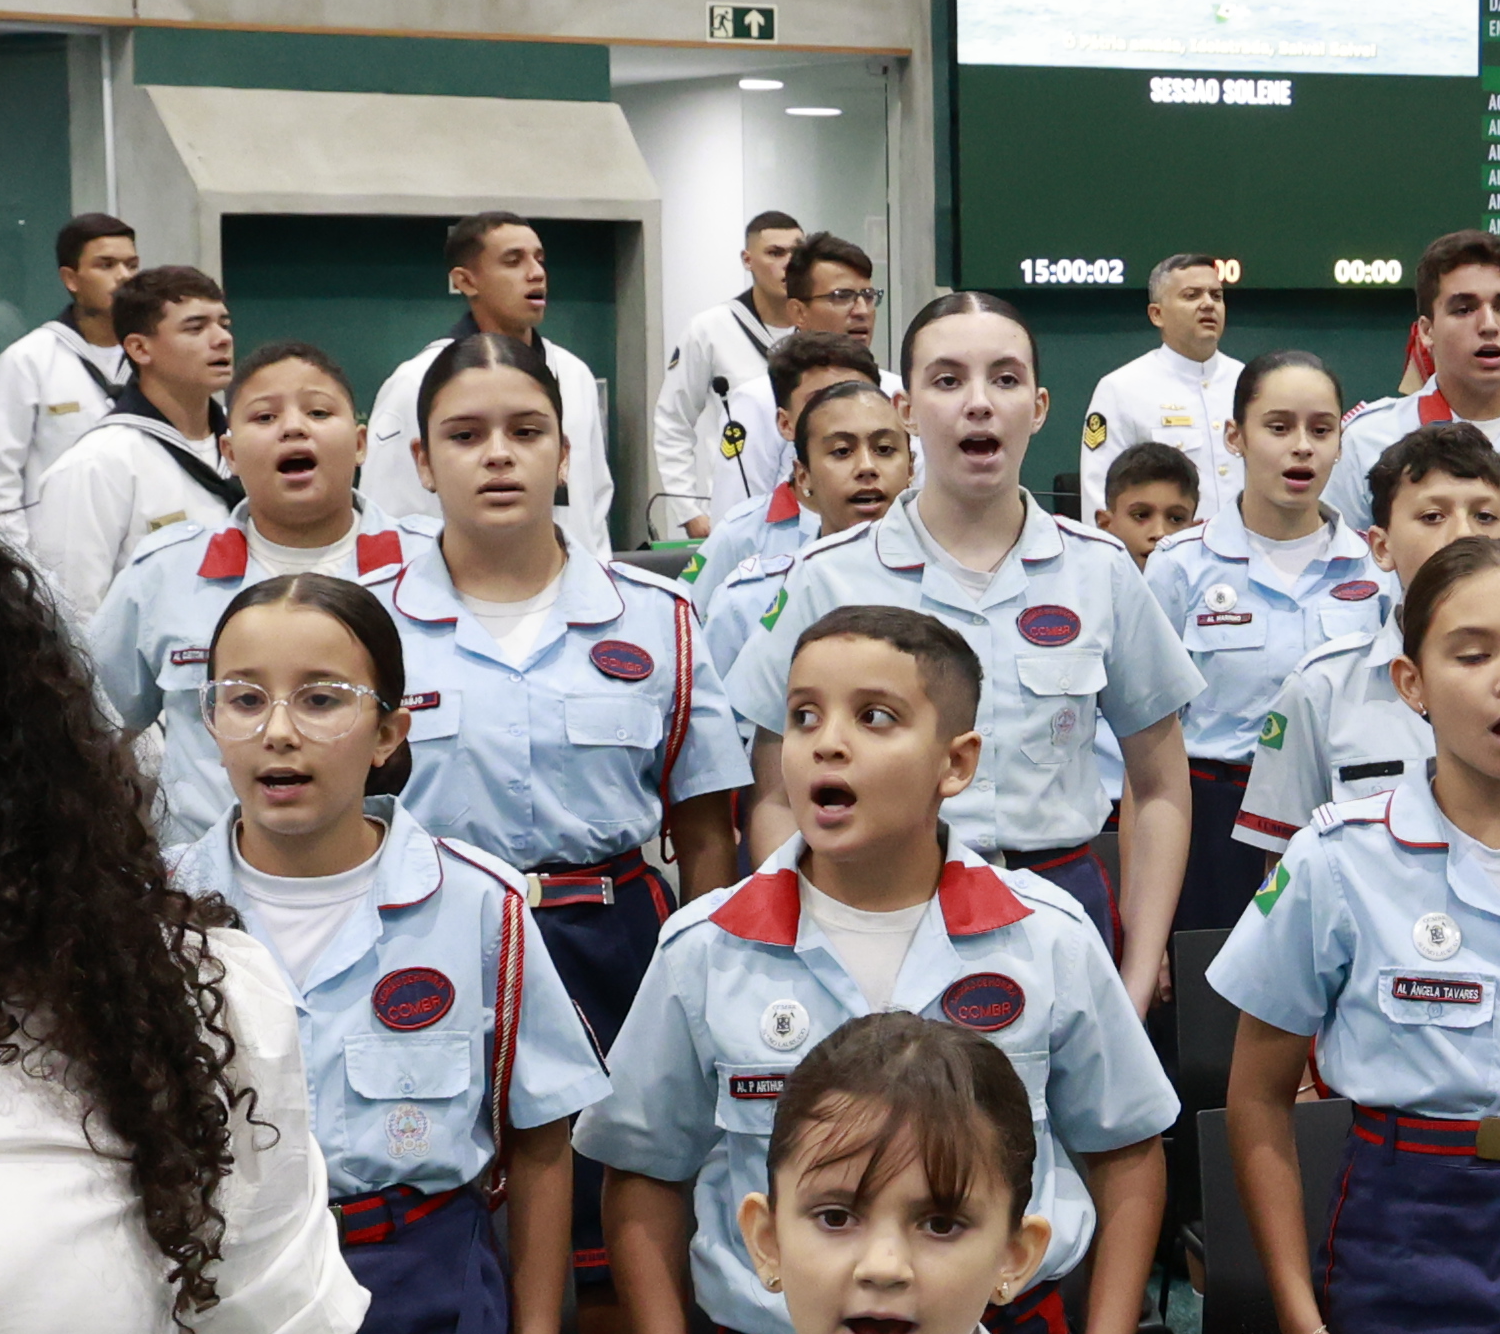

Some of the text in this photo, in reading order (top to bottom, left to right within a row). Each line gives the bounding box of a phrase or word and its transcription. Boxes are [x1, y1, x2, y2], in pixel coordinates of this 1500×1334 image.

[1222, 79, 1291, 105] SOLENE
[1021, 259, 1124, 283] 15:00:02
[1334, 259, 1402, 284] 00:00
[1397, 981, 1479, 1002] AL ÂNGELA TAVARES
[388, 995, 442, 1022] CCMBR
[958, 1002, 1012, 1020] CCMBR
[737, 1080, 747, 1093] AL
